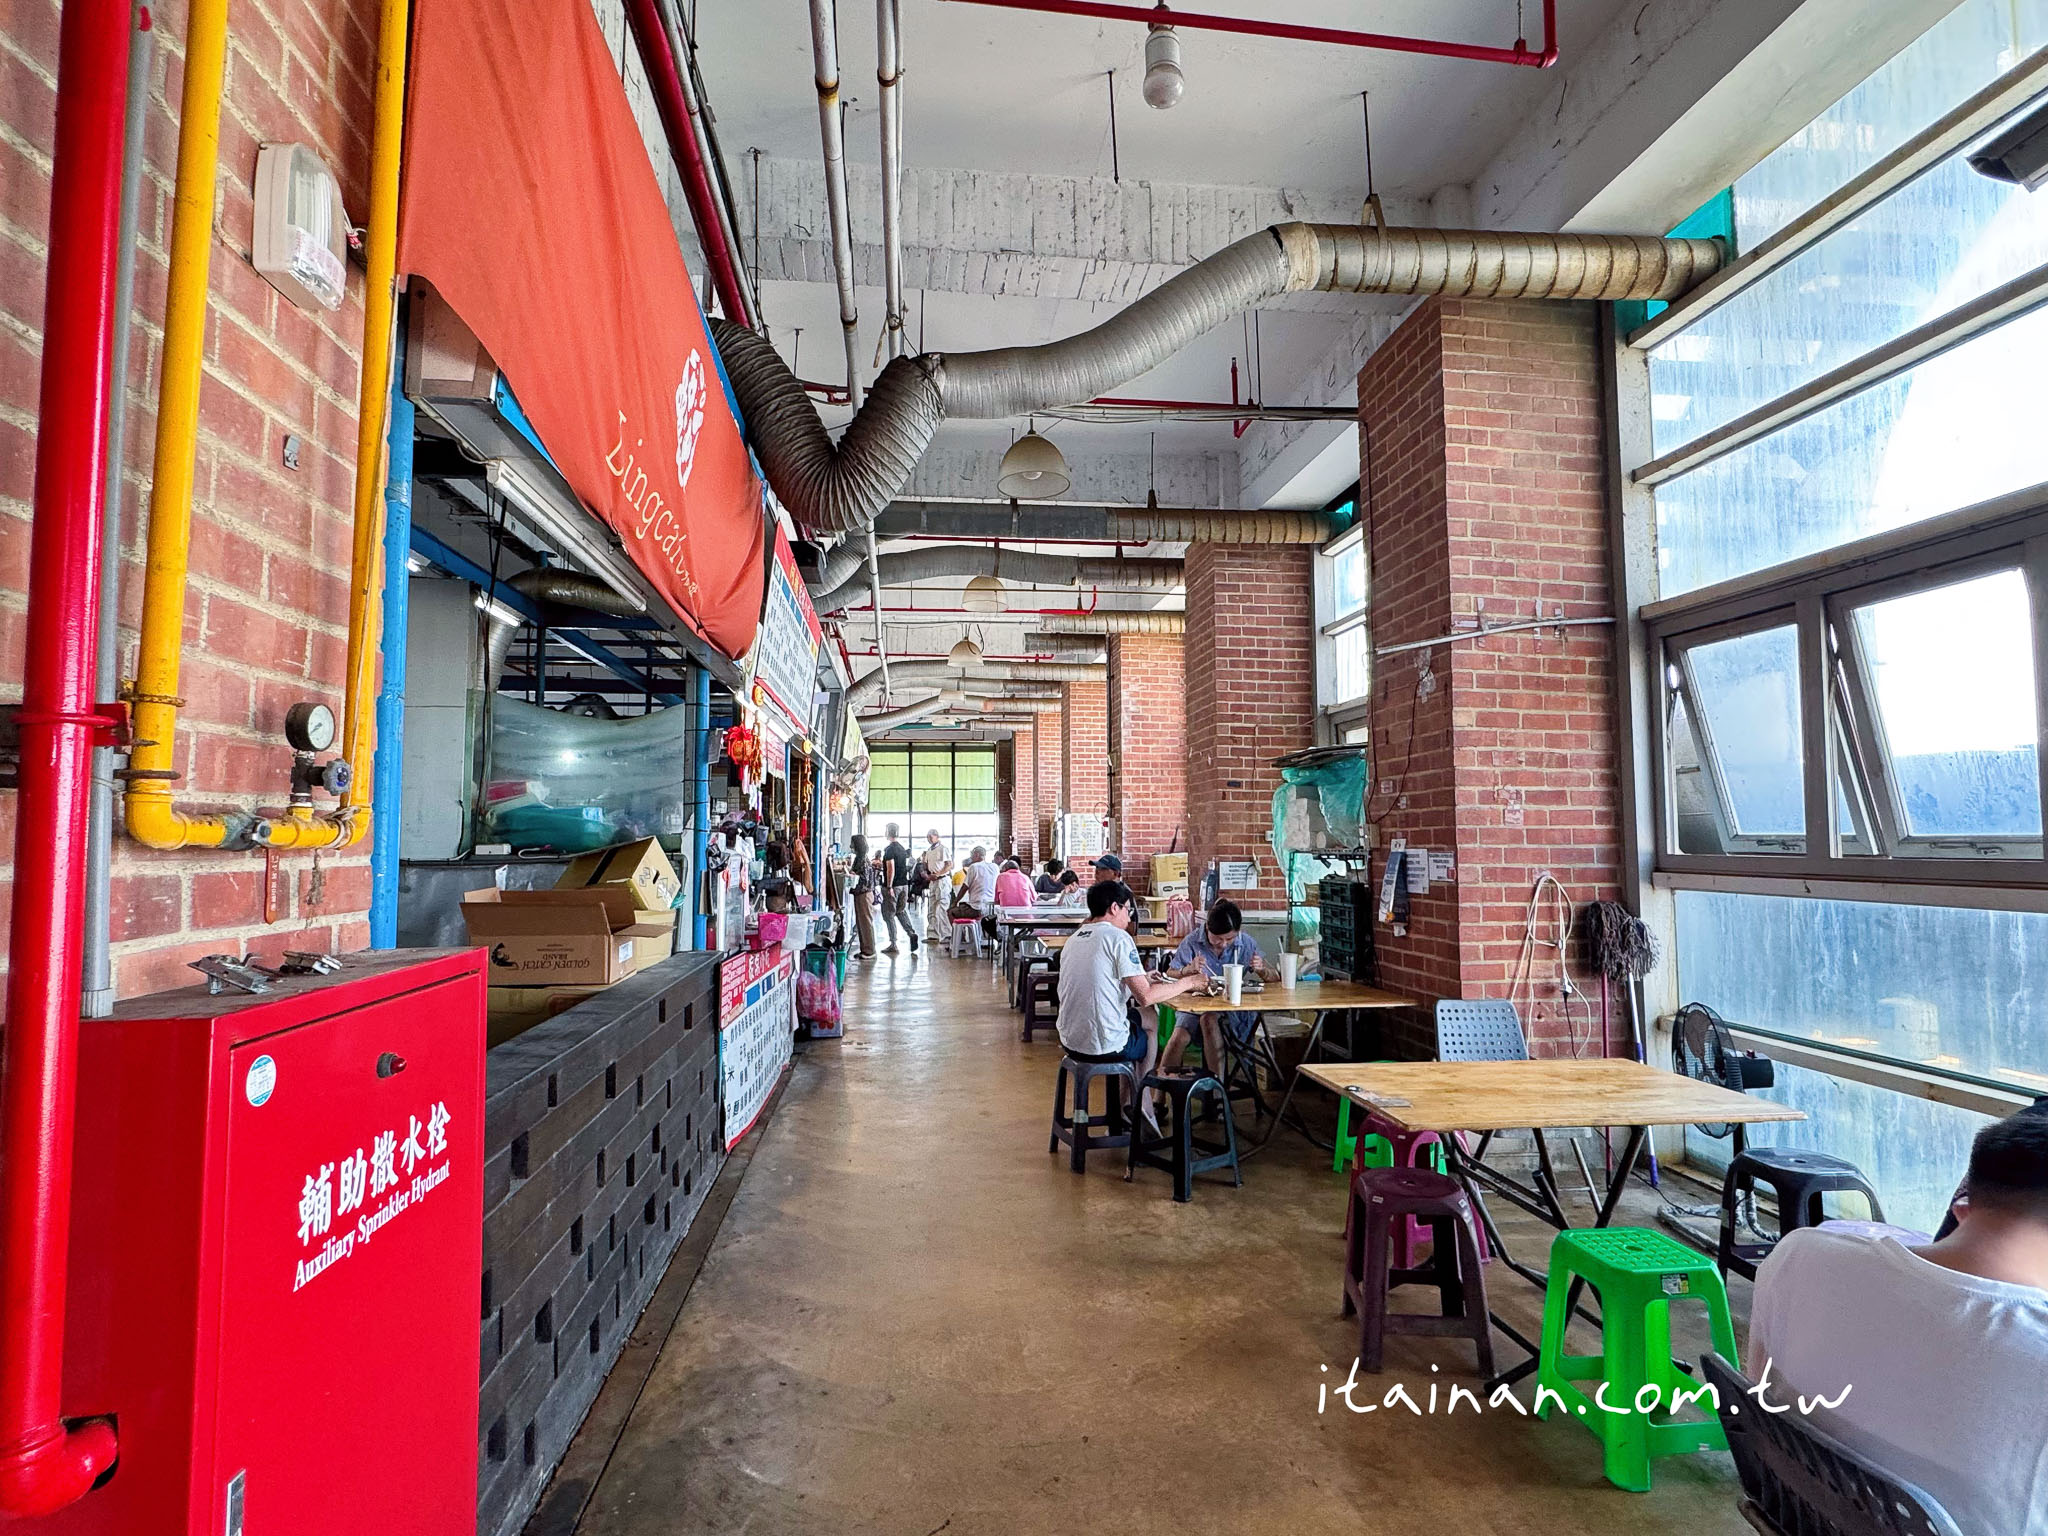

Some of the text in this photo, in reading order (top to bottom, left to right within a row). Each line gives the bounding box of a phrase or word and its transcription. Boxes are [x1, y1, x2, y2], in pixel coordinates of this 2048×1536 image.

[521, 958, 590, 971] GOLDEN CATCH
[293, 1159, 451, 1293] Auxiliary Sprinkler Hydrant
[297, 1101, 451, 1246] 輔助撒水栓
